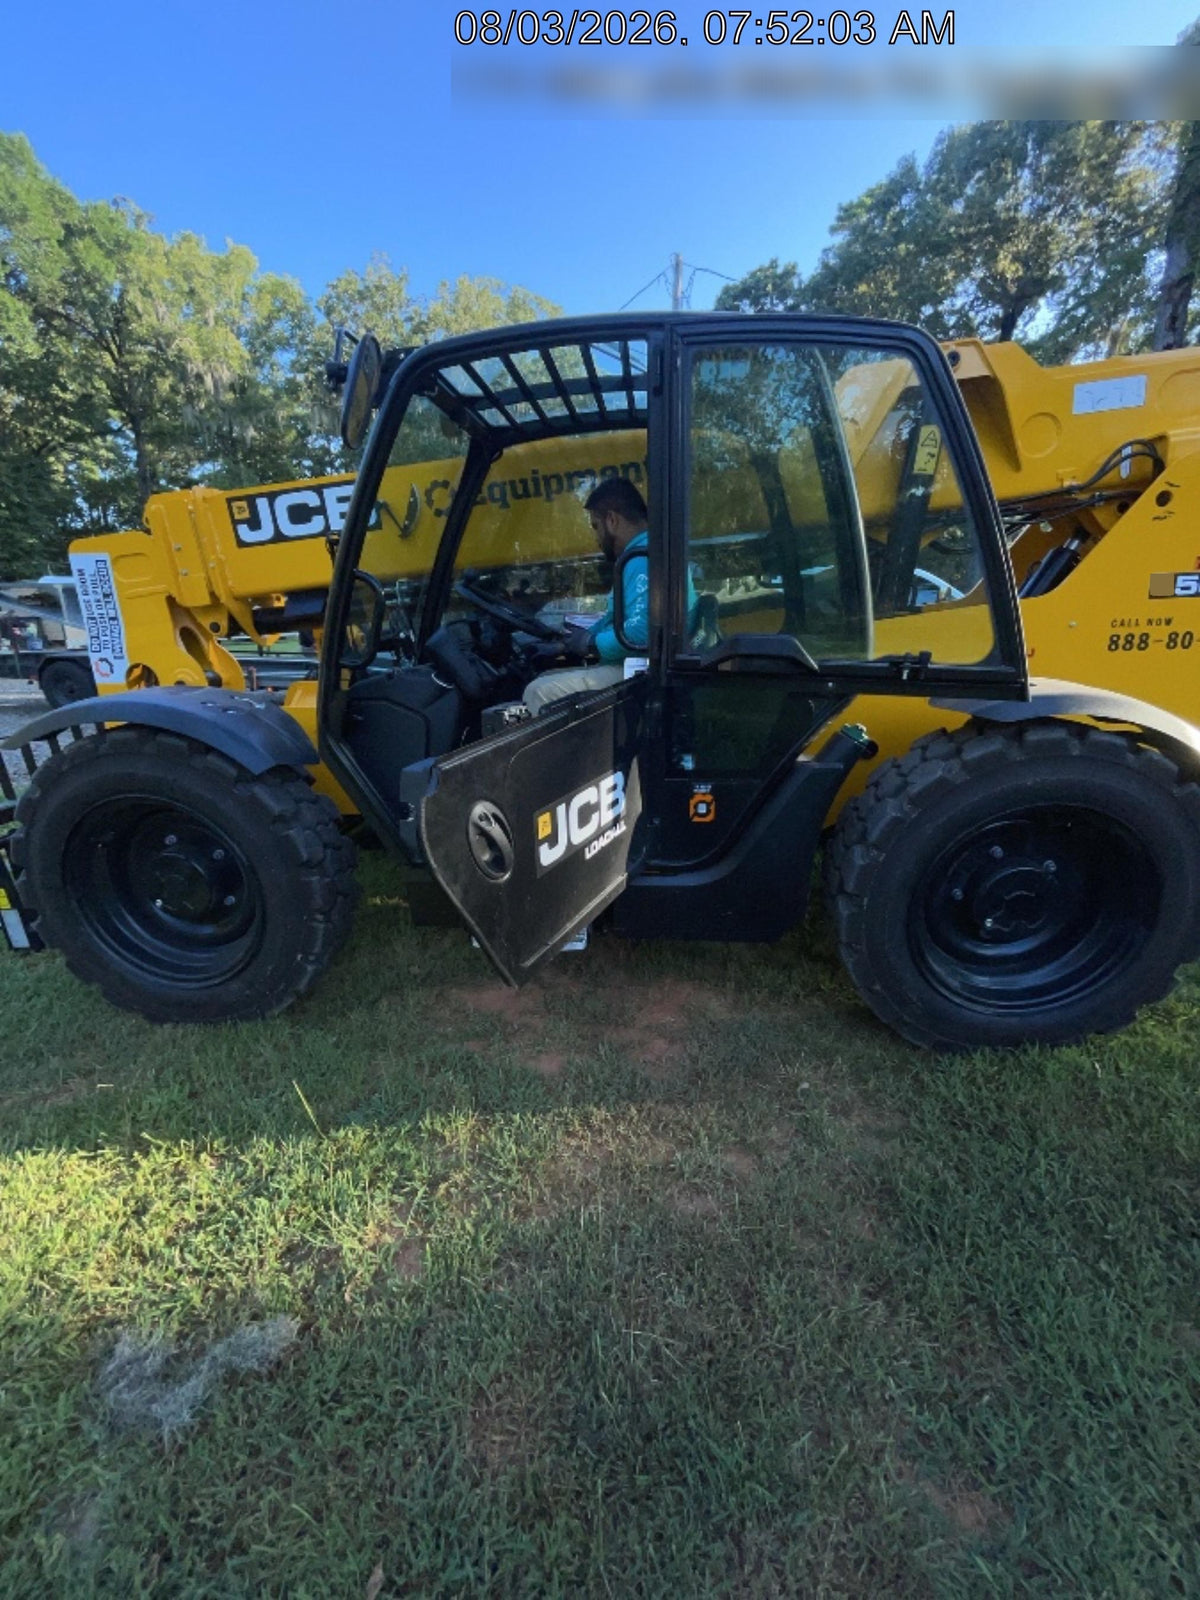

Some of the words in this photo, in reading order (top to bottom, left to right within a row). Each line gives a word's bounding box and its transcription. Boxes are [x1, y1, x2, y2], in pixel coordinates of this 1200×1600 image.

[1174, 575, 1200, 596] 5
[98, 612, 109, 637] PUSH
[1110, 618, 1140, 628] CALL
[1146, 616, 1174, 627] NOW
[102, 638, 111, 651] TO
[538, 771, 627, 867] JCB
